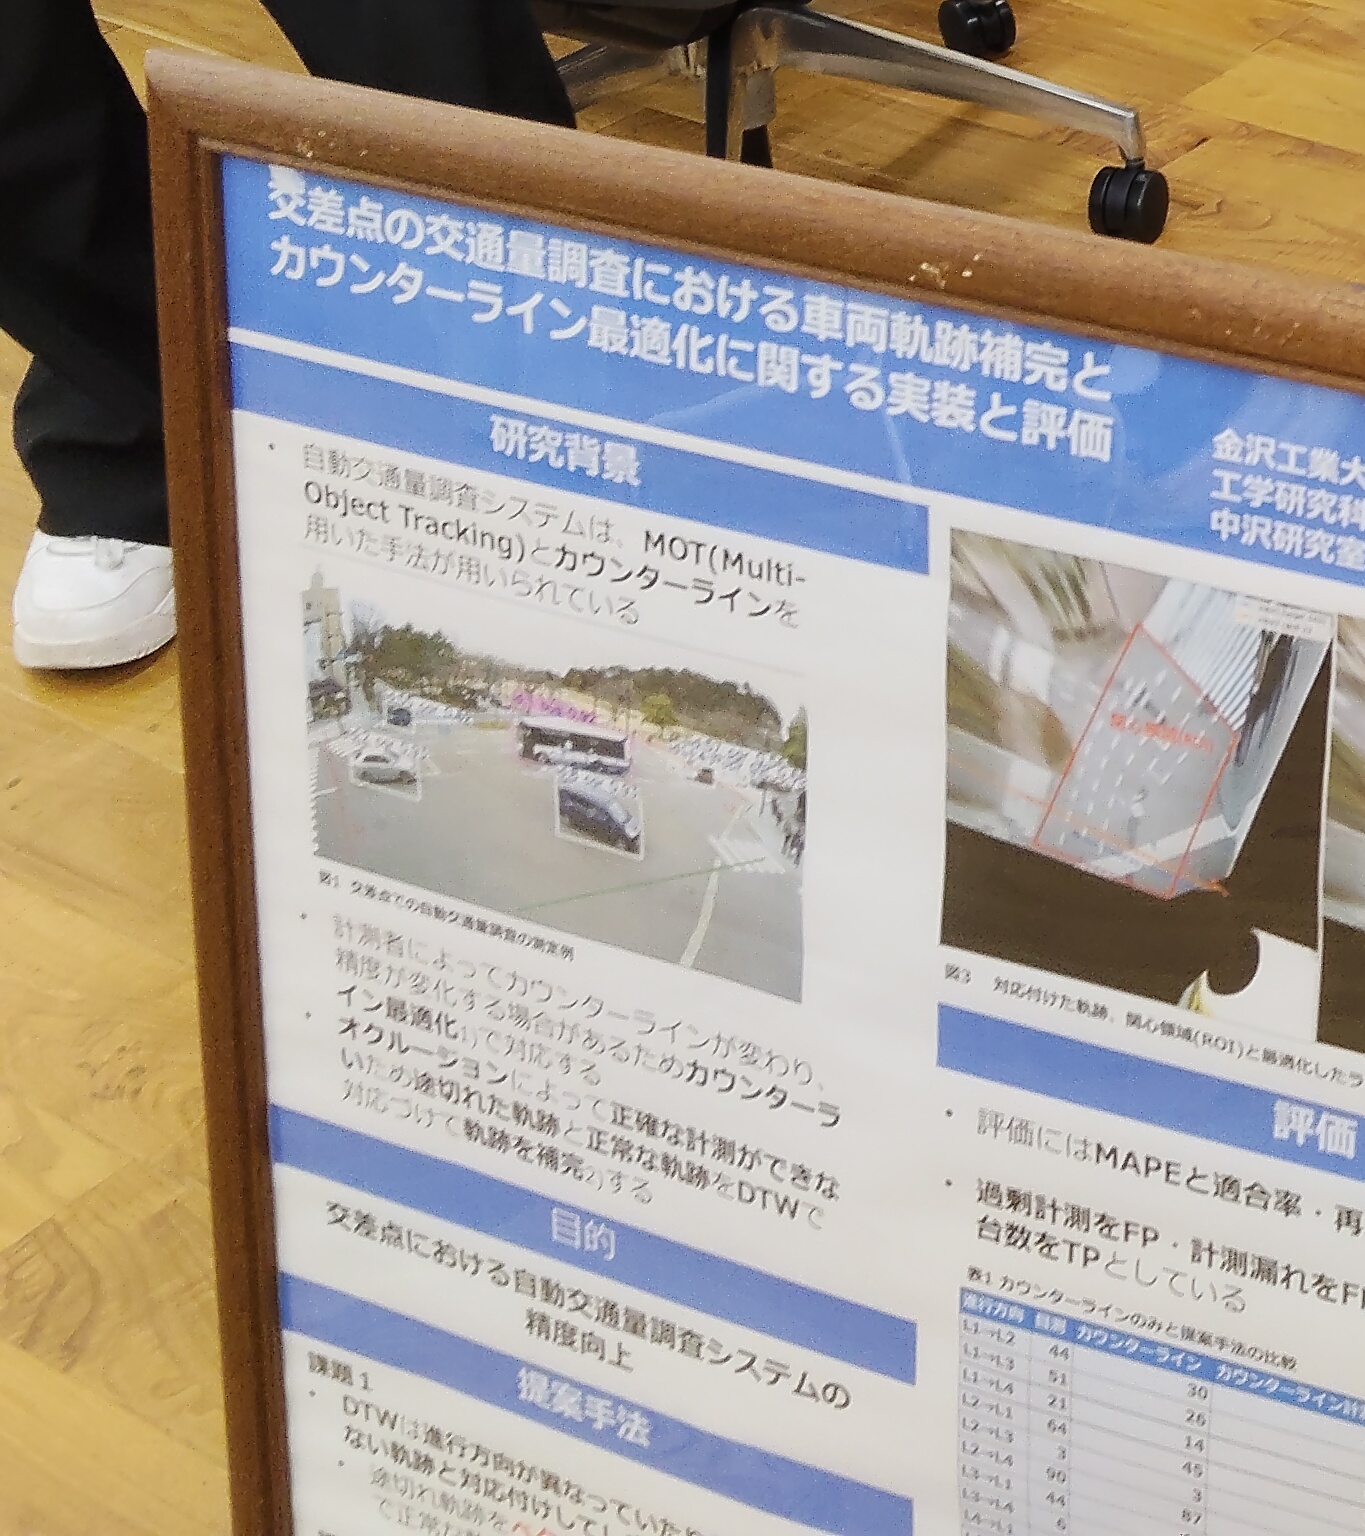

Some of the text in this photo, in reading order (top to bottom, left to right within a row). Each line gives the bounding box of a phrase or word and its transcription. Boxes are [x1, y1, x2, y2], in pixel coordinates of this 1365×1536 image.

[270, 236, 1113, 464] カウンターライン最適化に関する実装と評価
[489, 417, 641, 488] 研究背景
[303, 480, 390, 530] Object
[304, 514, 642, 627] 用いた手法が用いられている
[1272, 1099, 1358, 1162] 評価
[550, 1207, 617, 1263] 目的
[976, 1215, 1248, 1314] 台数をTPとしている
[325, 1198, 852, 1411] 交差点における自動交通量調査システムの
[524, 1306, 635, 1373] 精度向上
[516, 1364, 651, 1450] 提案手法
[1187, 1382, 1209, 1401] 30
